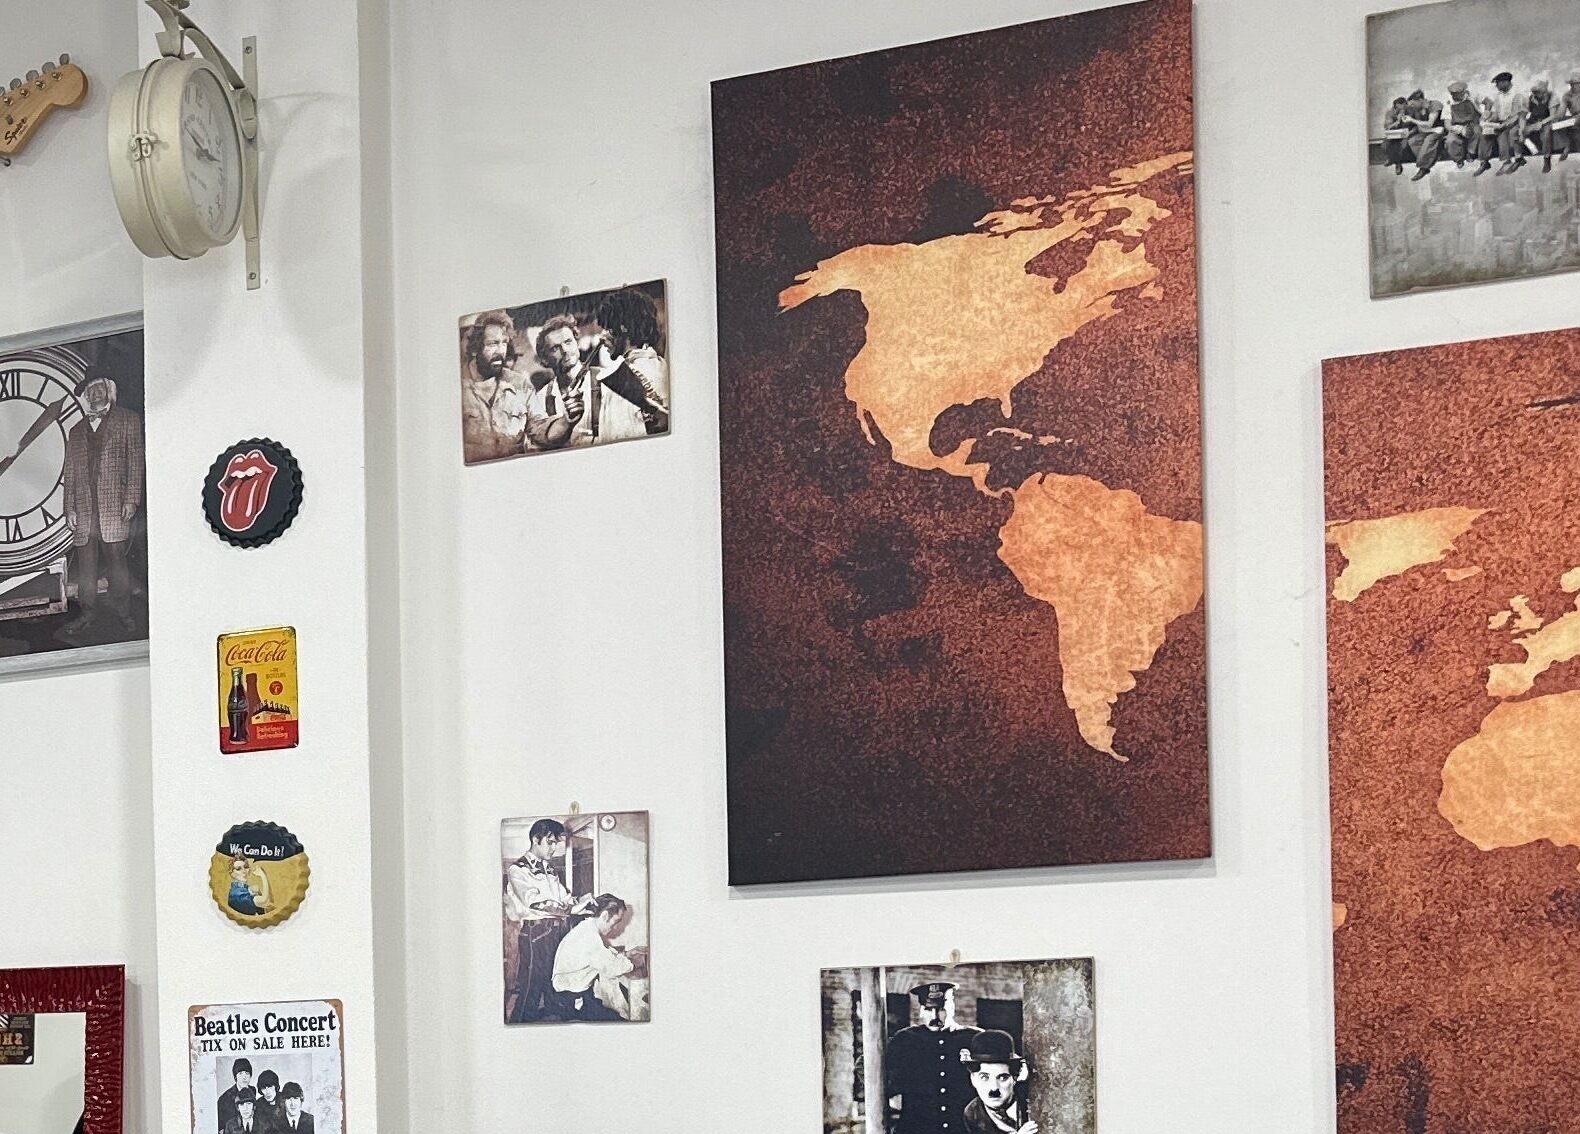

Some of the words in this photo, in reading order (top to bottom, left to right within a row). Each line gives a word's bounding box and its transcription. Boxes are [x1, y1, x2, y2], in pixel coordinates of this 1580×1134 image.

[226, 640, 288, 667] Coca-Cola
[230, 844, 243, 854] We
[243, 844, 260, 856] Can
[261, 845, 273, 856] Do
[274, 845, 286, 857] It!
[194, 1013, 259, 1037] Beatles
[264, 1010, 337, 1034] Concert
[201, 1039, 222, 1052] TIX
[229, 1037, 247, 1051] ON
[253, 1036, 285, 1050] SALE
[291, 1034, 331, 1048] HERE!
